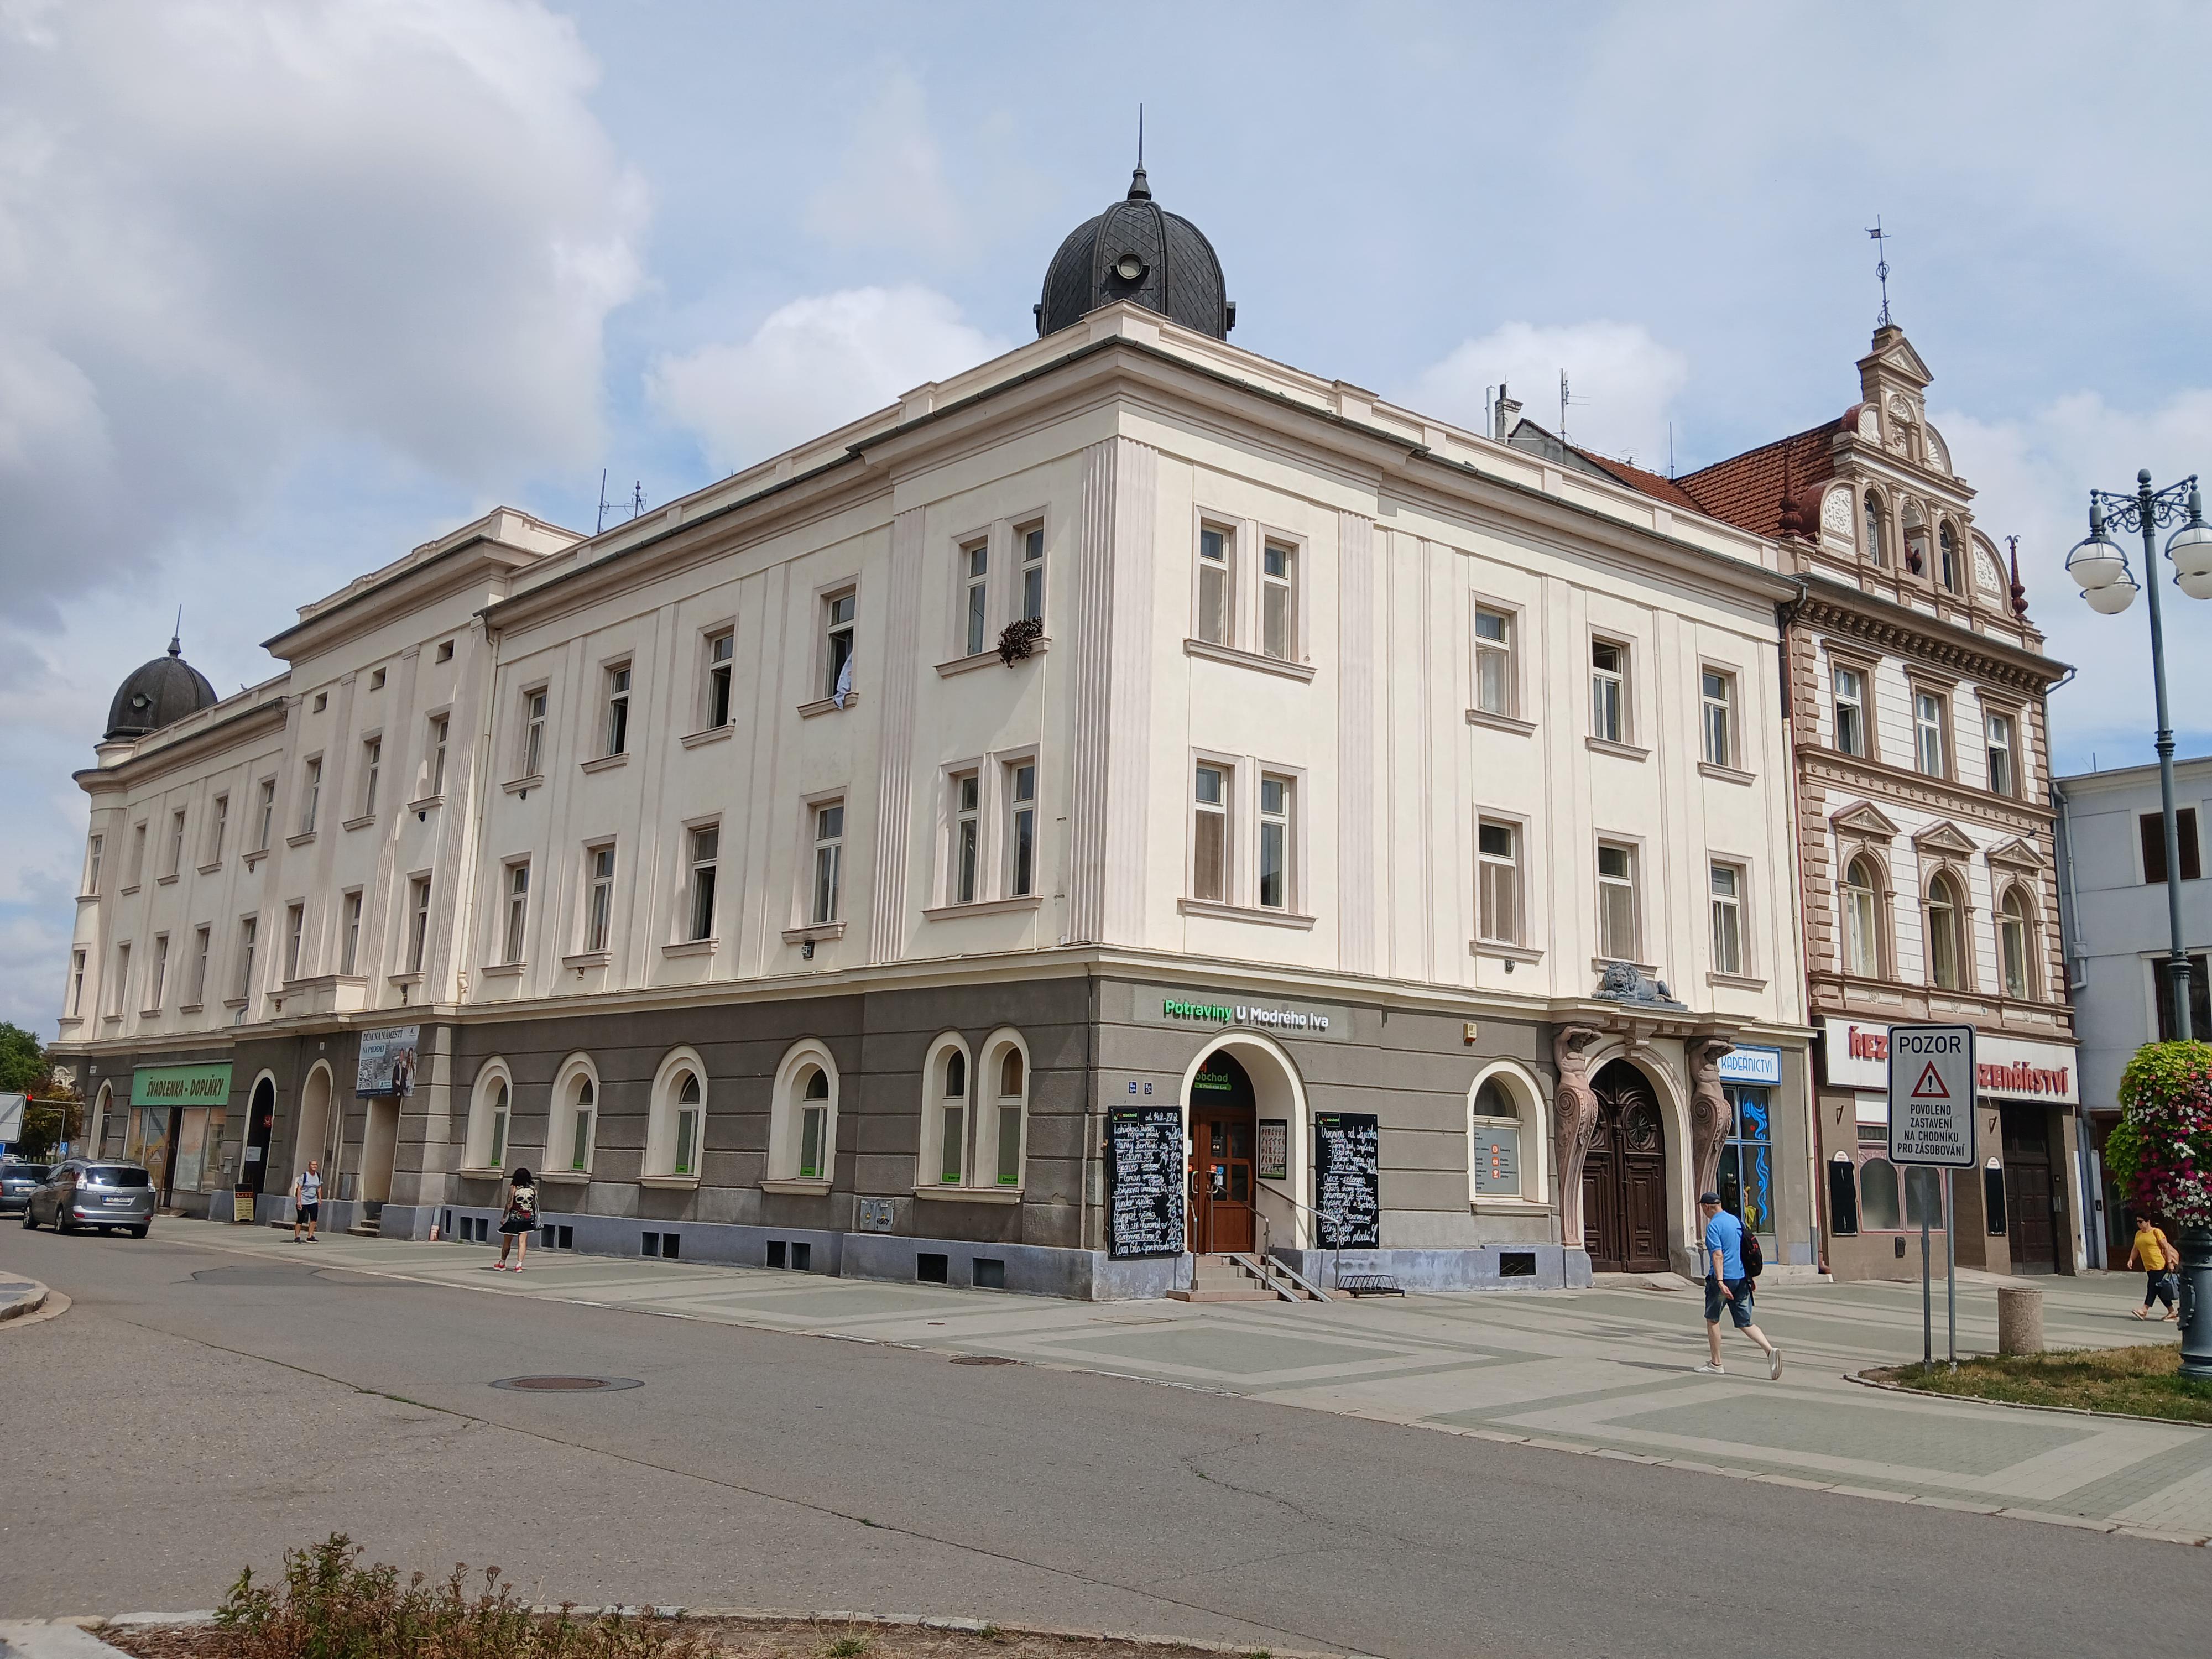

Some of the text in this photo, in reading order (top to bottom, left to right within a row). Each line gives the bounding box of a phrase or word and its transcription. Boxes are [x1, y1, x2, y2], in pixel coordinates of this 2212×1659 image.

[1165, 999, 1233, 1021] Potraviny
[1236, 1006, 1246, 1019] U
[1250, 1007, 1306, 1025] Modrého
[1899, 1036, 1961, 1053] POZOR
[1721, 1055, 1773, 1073] KADEŘNICTVÍ
[1196, 1072, 1228, 1082] obchod
[147, 1077, 184, 1097] ŠVADLENKA
[190, 1074, 224, 1097] DOPLŇKY
[1911, 1104, 1951, 1115] POVOLENO
[1910, 1116, 1953, 1129] ZASTAVENÍ
[1904, 1129, 1958, 1142] NA CHODNÍKU
[1897, 1142, 1965, 1156] PRO ZÁSOBOVÁNÍ
[1116, 1151, 1142, 1161] Eidam
[1118, 1172, 1141, 1182] Florian
